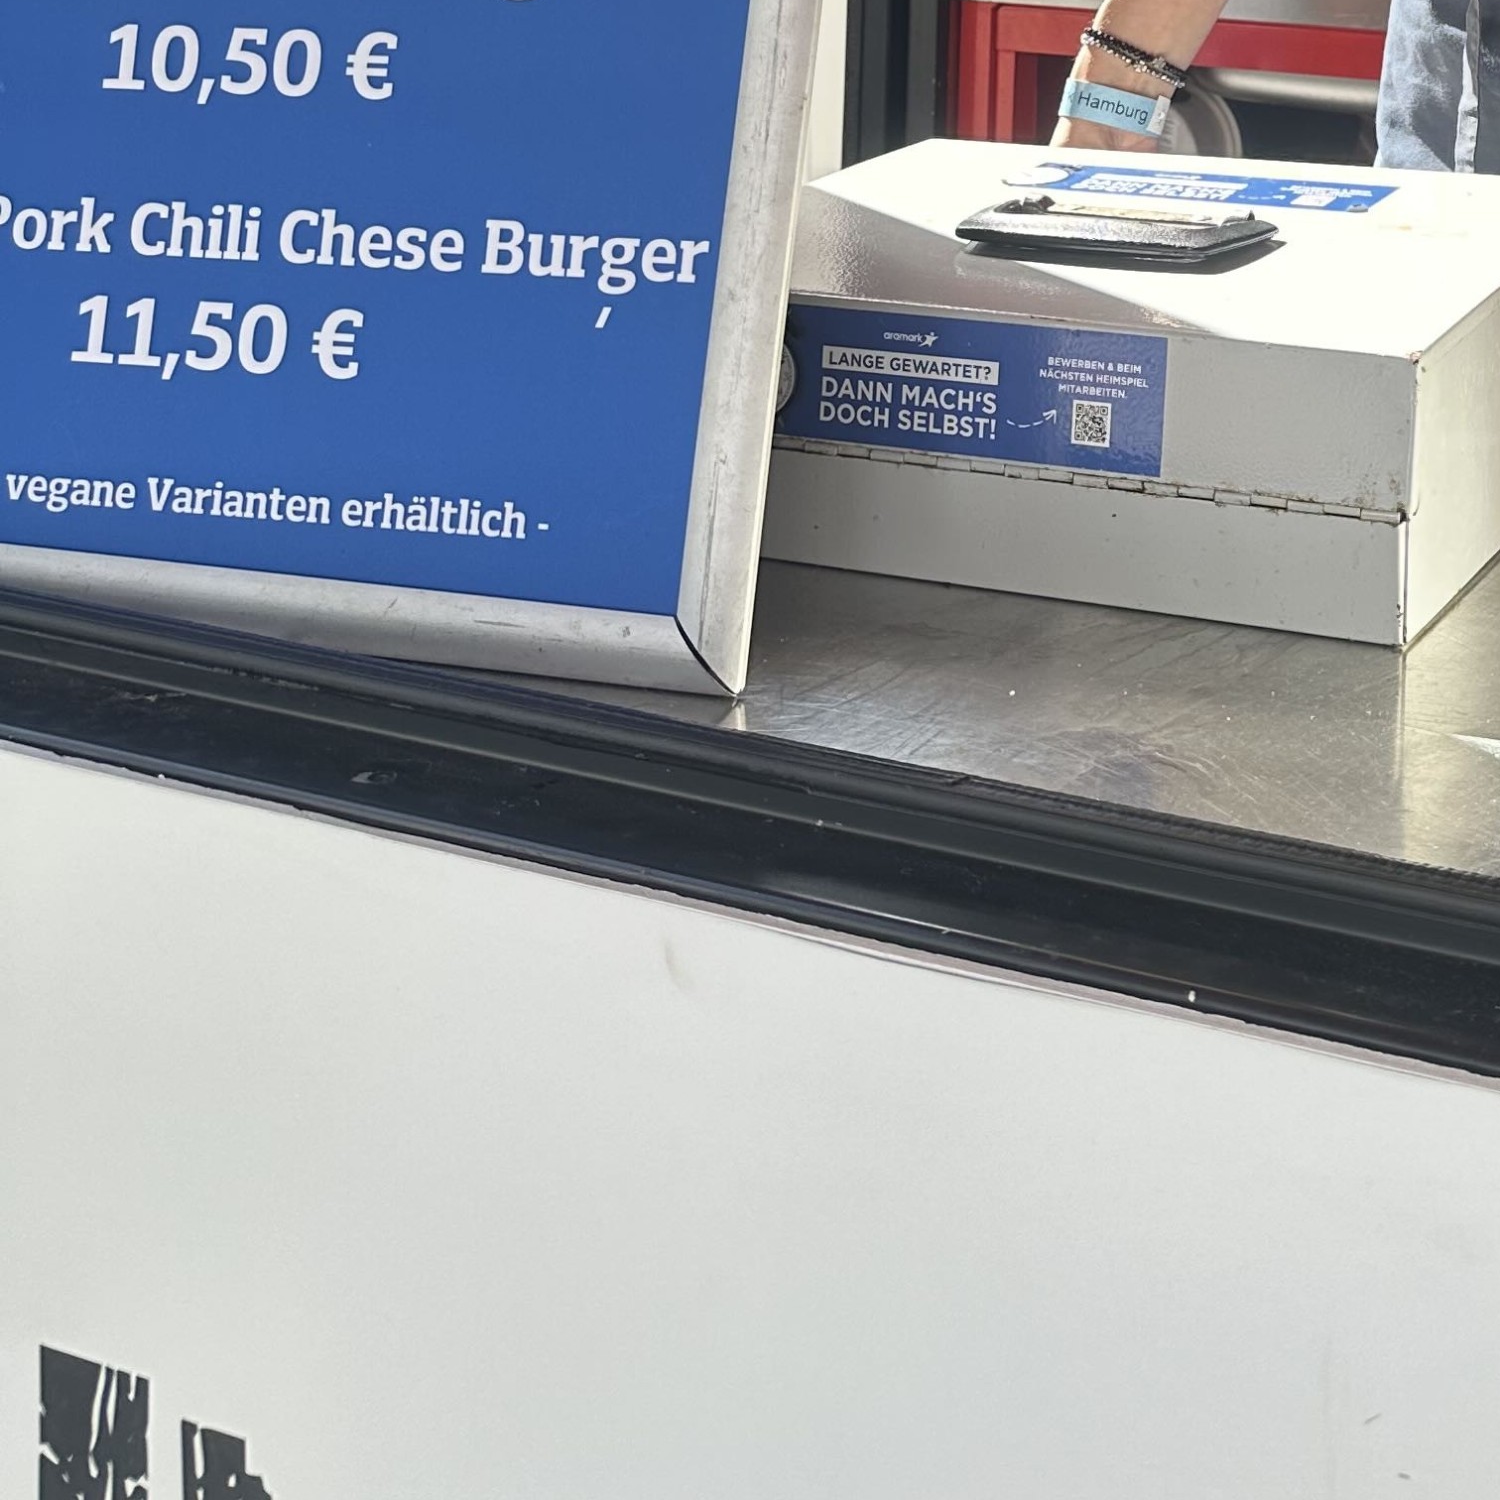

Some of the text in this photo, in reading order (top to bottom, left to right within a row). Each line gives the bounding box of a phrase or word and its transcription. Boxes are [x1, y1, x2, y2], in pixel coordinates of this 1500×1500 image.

[102, 23, 399, 105] 10,50 €
[1077, 91, 1150, 125] Hamburg
[130, 201, 262, 261] Chili
[279, 208, 465, 273] Chese
[481, 219, 710, 295] Burger
[70, 294, 365, 381] 11,50 €
[828, 351, 992, 381] LANGE GEWARTET?
[1039, 368, 1149, 389] NÄCHSTEN HEIMSPIEL
[1047, 356, 1105, 371] BEWERBEN
[1117, 364, 1142, 374] BEIM
[821, 376, 893, 404] DANN
[819, 400, 997, 440] DOCH SELBST!
[6, 473, 137, 513] vegane
[147, 476, 331, 524] Varianten
[341, 492, 527, 540] erhältlich
